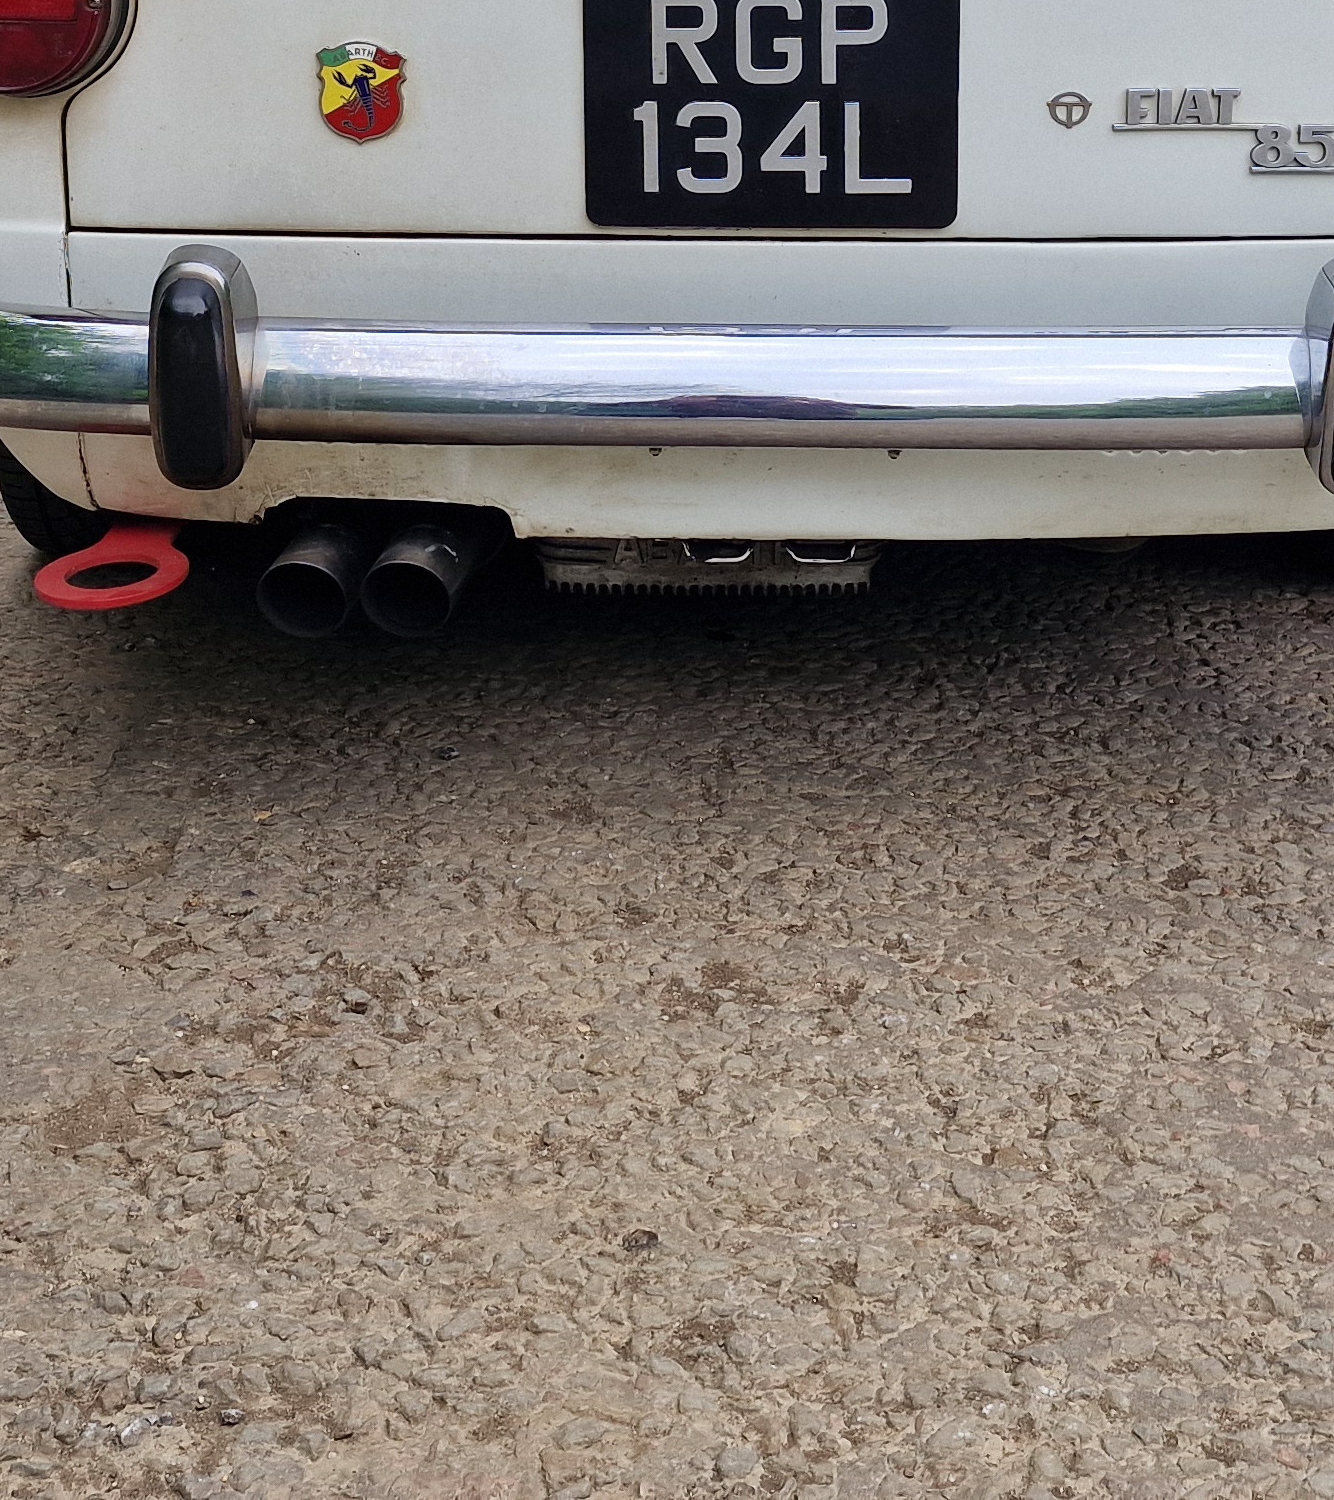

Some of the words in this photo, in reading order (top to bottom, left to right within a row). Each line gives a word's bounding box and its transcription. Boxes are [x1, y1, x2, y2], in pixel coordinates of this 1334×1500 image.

[332, 47, 374, 63] ABARTH
[1125, 87, 1242, 125] FIAT
[633, 100, 913, 194] 134L
